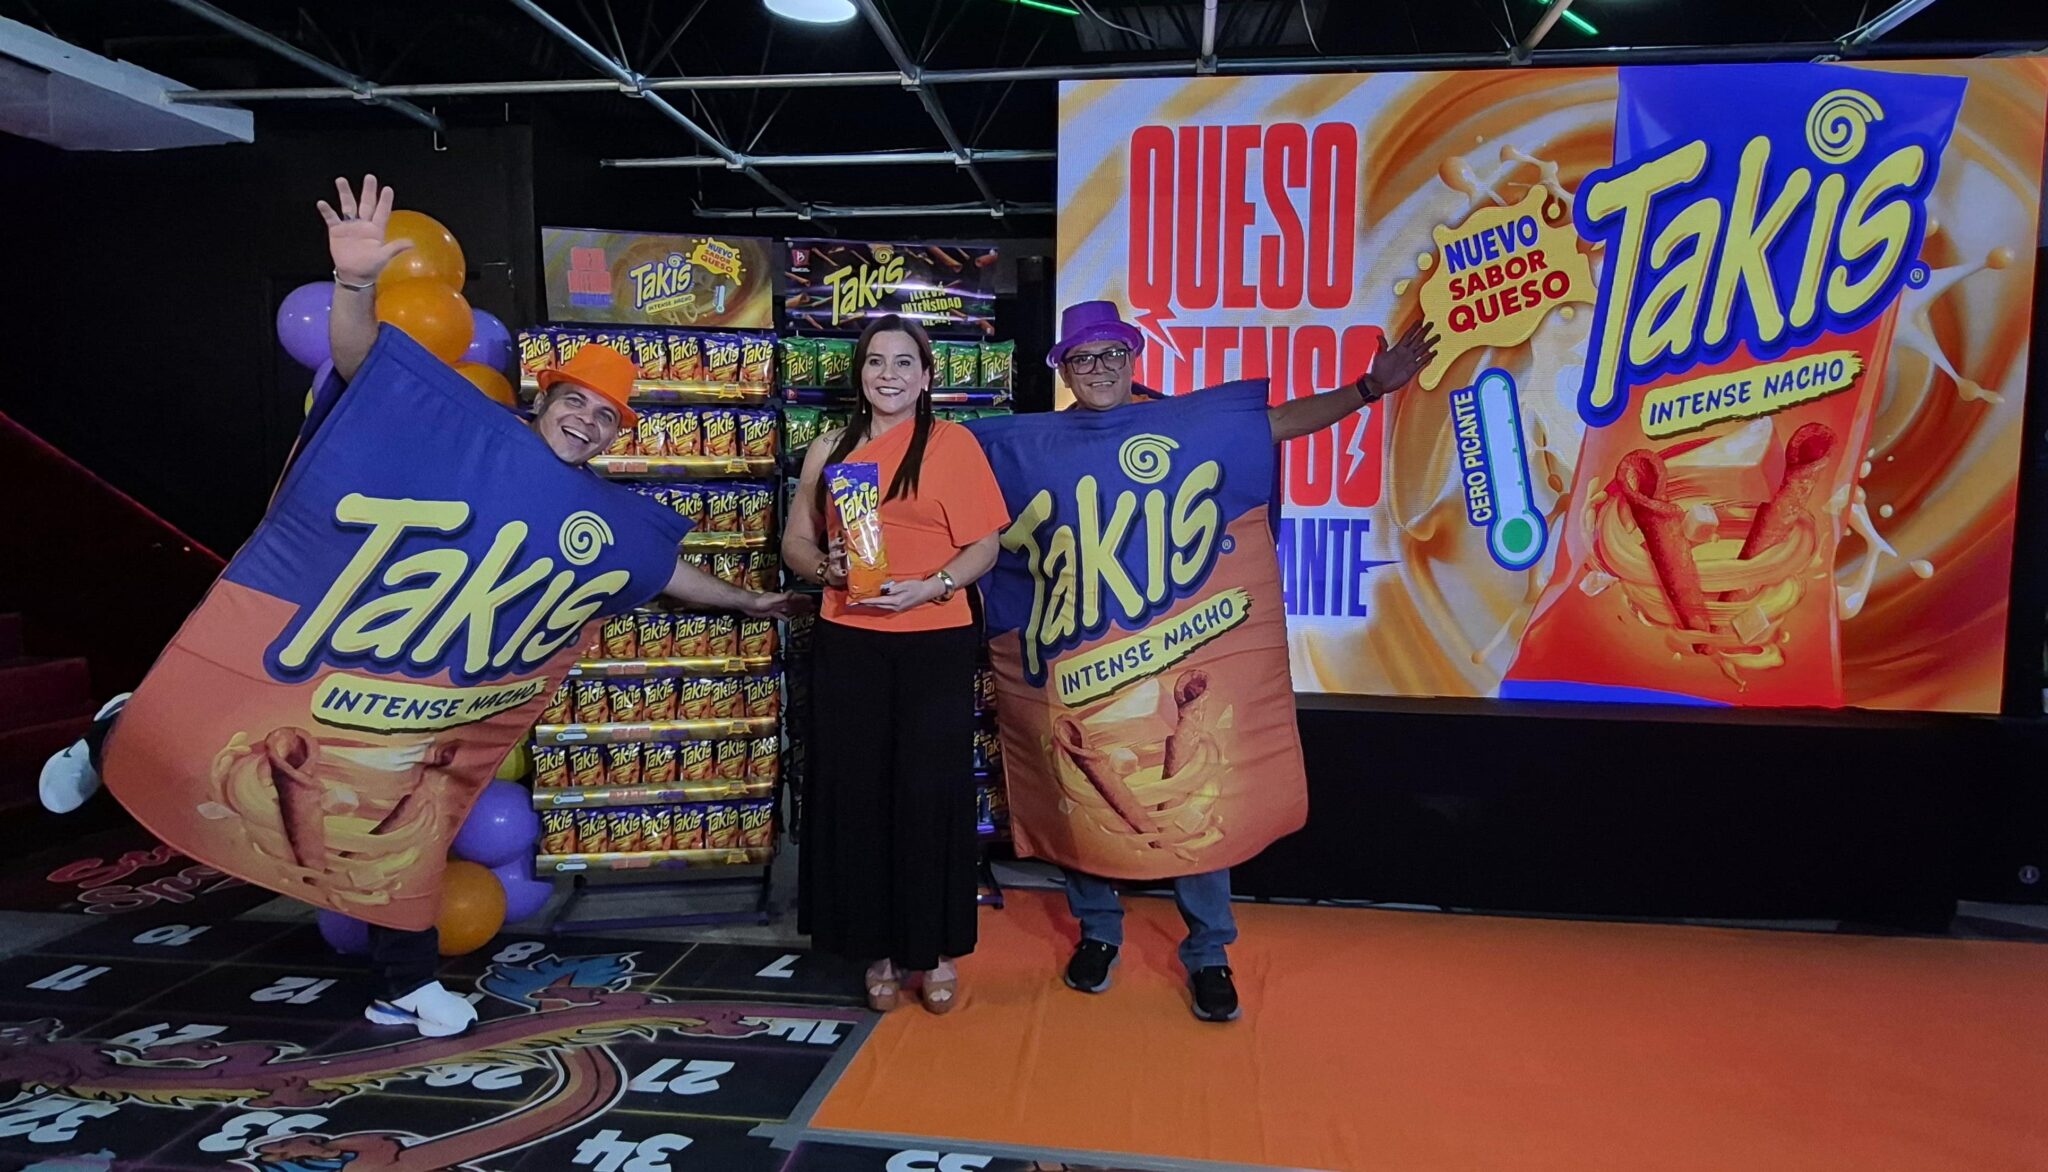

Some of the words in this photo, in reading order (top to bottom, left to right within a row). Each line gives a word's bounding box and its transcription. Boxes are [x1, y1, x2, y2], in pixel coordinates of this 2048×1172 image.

[1128, 122, 1358, 312] QUESO
[707, 243, 733, 259] NUEVO
[1444, 214, 1539, 274] NUEVO
[1586, 89, 1925, 408] Takis
[701, 254, 733, 273] QUESO
[1449, 249, 1548, 300] SABOR
[630, 254, 693, 308] Takis
[823, 248, 905, 326] Takis
[1447, 270, 1571, 333] QUESO
[519, 334, 551, 364] Takis
[669, 337, 698, 366] Takis
[706, 343, 739, 372] Takis
[742, 339, 774, 368] Takis
[787, 353, 814, 379] Takis
[982, 353, 1010, 379] Takis
[1649, 381, 1752, 426] INTENSE
[1763, 359, 1845, 398] NACHO
[638, 413, 666, 443] Takis
[667, 412, 698, 442] Takis
[704, 412, 734, 441] Takis
[742, 416, 772, 445] Takis
[789, 423, 815, 449] Takis
[1454, 391, 1485, 470] PICANTE
[708, 492, 739, 519] Takis
[739, 491, 769, 519] Takis
[835, 483, 878, 529] Takis
[1467, 471, 1493, 523] CERO
[1000, 434, 1218, 674] Takis
[279, 493, 630, 674] Takis
[604, 615, 634, 641] Takis
[639, 619, 670, 645] Takis
[675, 616, 706, 641] Takis
[1062, 640, 1154, 695] INTENSE
[1164, 598, 1234, 650] NACHO
[321, 687, 464, 721] INTENSE
[466, 683, 538, 714] NACHO
[610, 685, 641, 712] Takis
[644, 679, 674, 706] Takis
[682, 681, 711, 704] Takis
[744, 677, 774, 704] Takis
[533, 748, 565, 776] Takis
[571, 748, 599, 775] Takis
[681, 741, 712, 768] Takis
[716, 740, 745, 764] Takis
[578, 815, 607, 840] Takis
[609, 814, 641, 841] Takis
[706, 807, 738, 835] Takis
[741, 806, 772, 832] Takis
[132, 923, 213, 947] 10
[491, 940, 545, 963] 8
[25, 964, 112, 990] 11
[755, 954, 801, 978] 7
[249, 976, 339, 1003] 12
[628, 1058, 736, 1095] 27
[570, 1129, 695, 1172] 34
